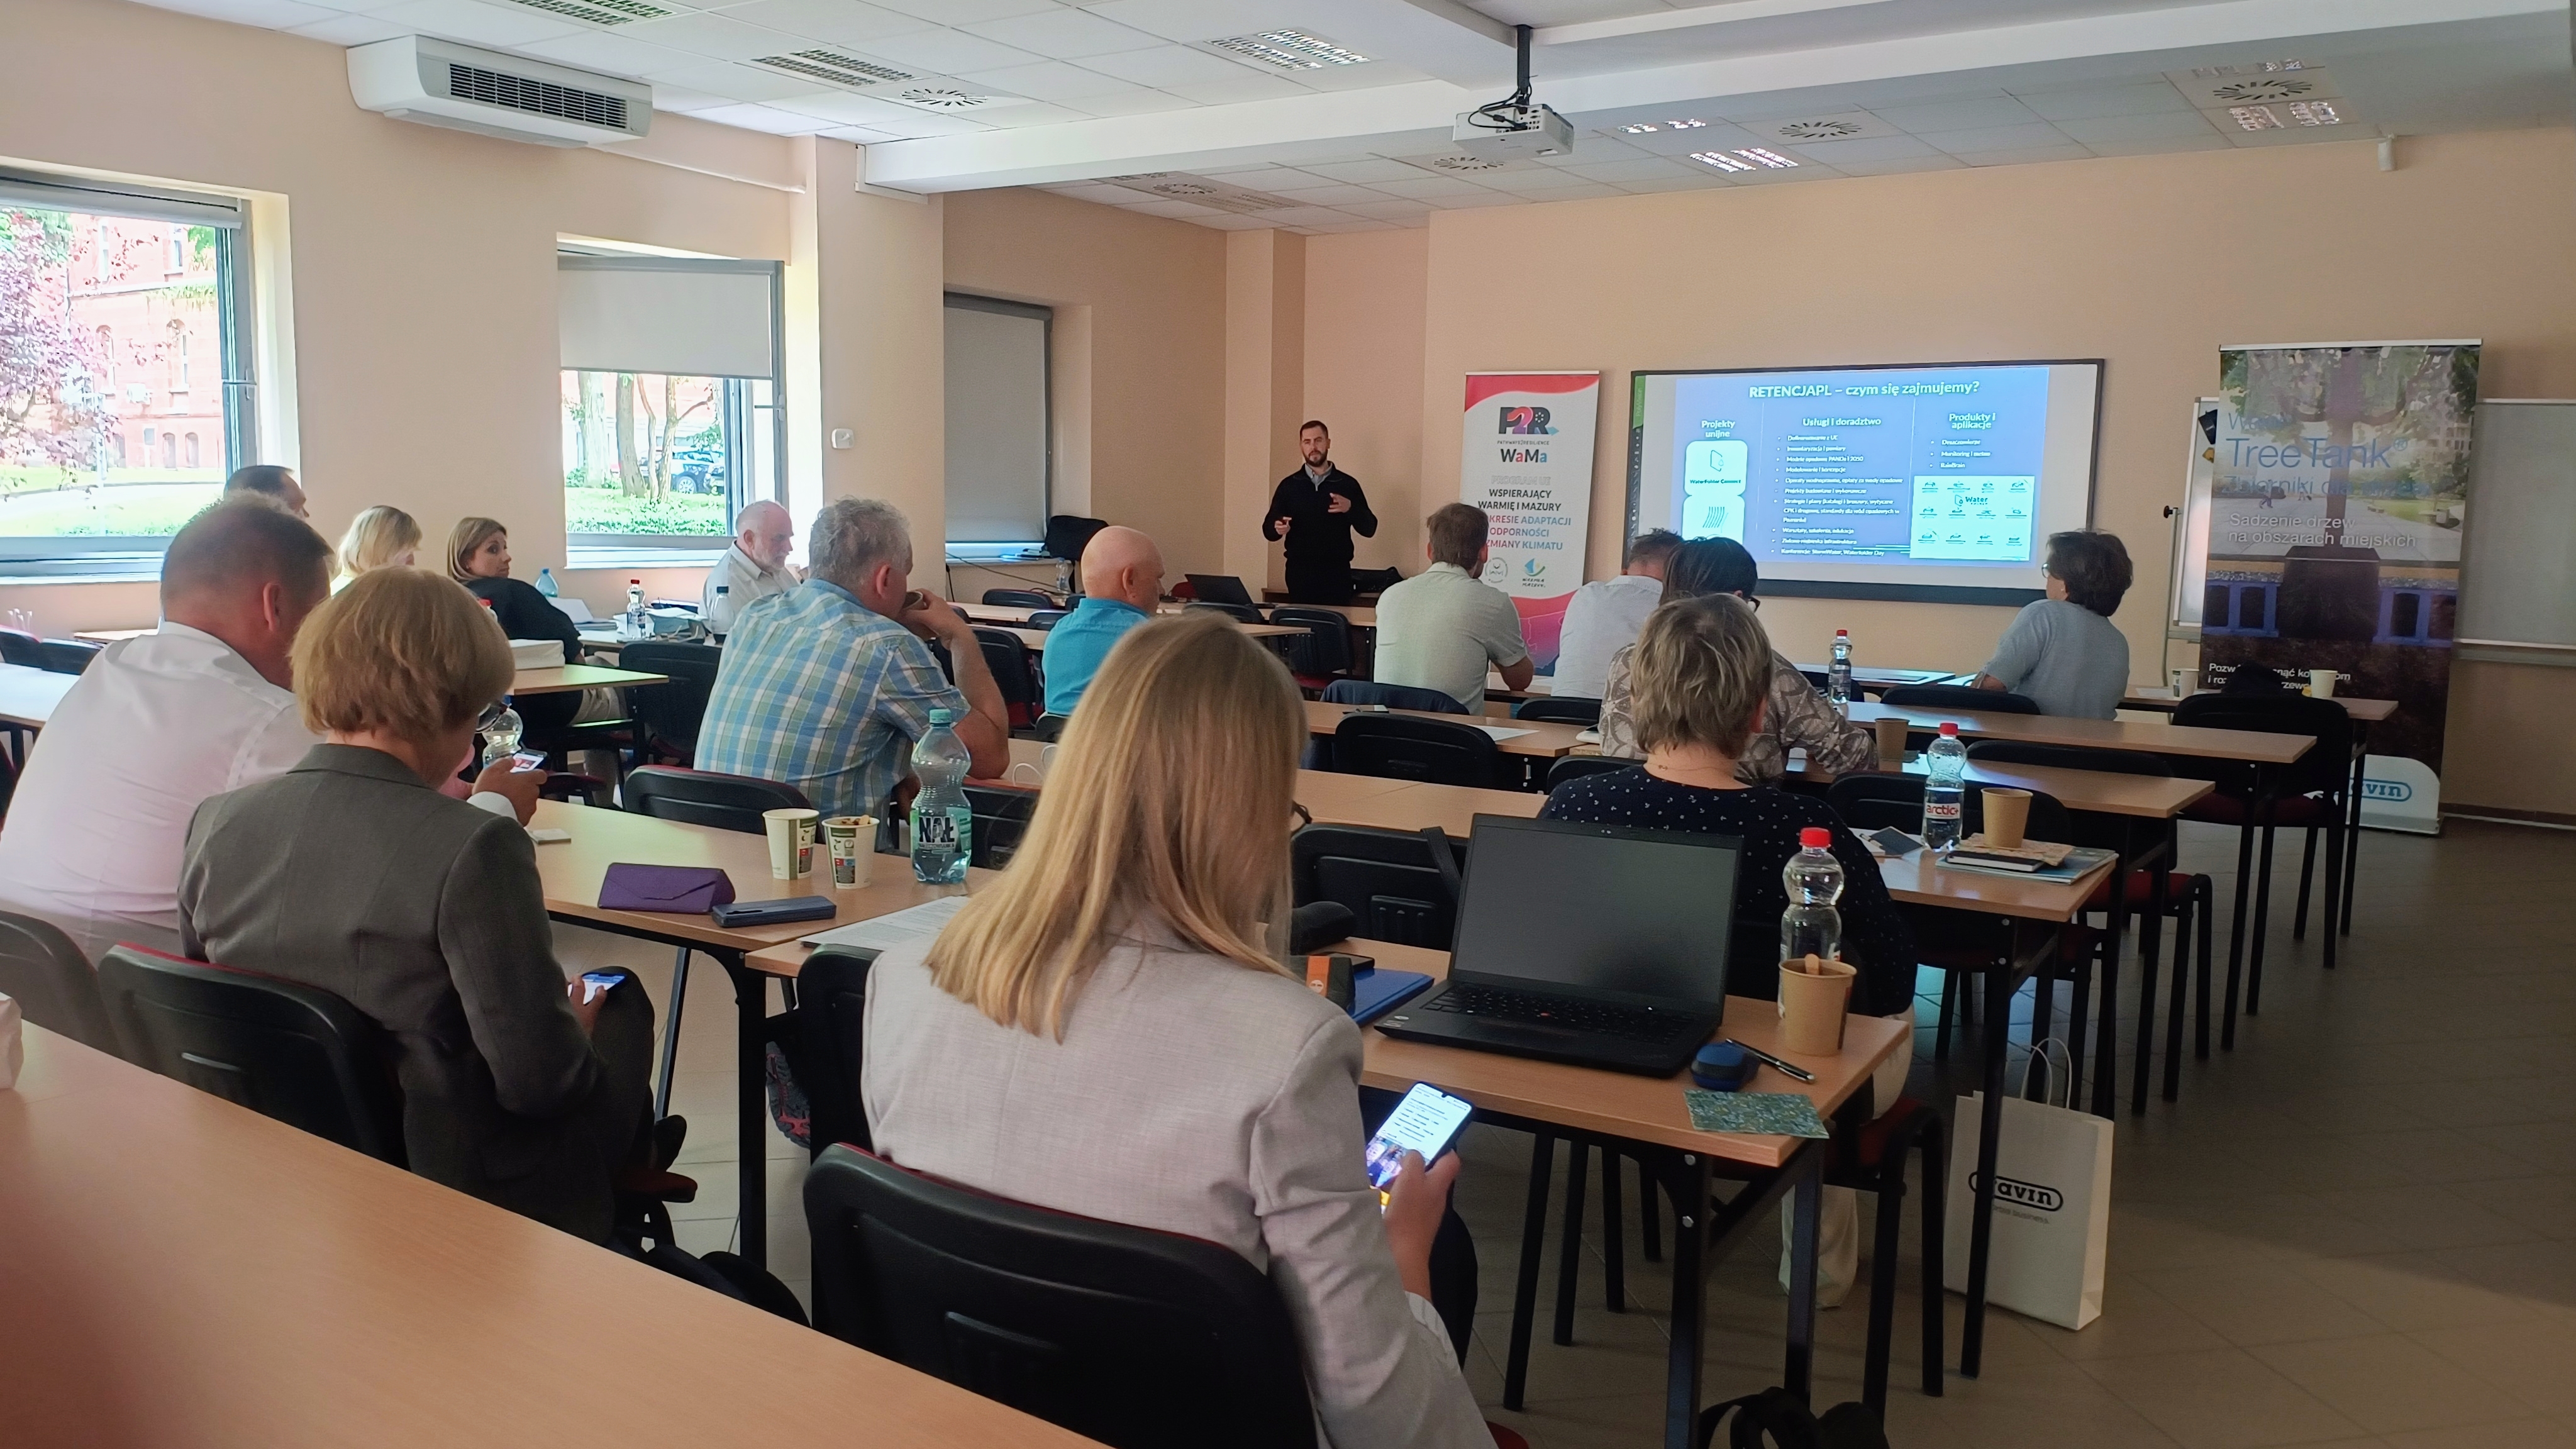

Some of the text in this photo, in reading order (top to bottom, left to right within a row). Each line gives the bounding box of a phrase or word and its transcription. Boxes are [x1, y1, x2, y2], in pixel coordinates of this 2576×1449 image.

[1749, 386, 1831, 398] RETENCJAPL
[1845, 386, 1879, 397] czym
[1881, 383, 1899, 396] się
[1902, 381, 1980, 396] zajmujemy?
[1499, 406, 1550, 434] P2R
[1948, 412, 1996, 422] Produkty i
[1701, 419, 1736, 429] Projekty
[1802, 418, 1829, 427] Usługi
[1835, 418, 1882, 426] doradztwo
[1951, 421, 1992, 430] aplikacje
[1705, 430, 1730, 439] unijne
[1501, 448, 1547, 463] WaMa
[1491, 475, 1552, 486] PROGRAM UE
[1489, 489, 1552, 499] WSPIERAJĄCY
[1478, 501, 1515, 511] WARMIĘ
[1521, 502, 1562, 511] MAZURY
[1489, 515, 1572, 526] KRESIE ADAPTACJI
[2229, 513, 2356, 528] Sadzenie drzew
[1489, 528, 1550, 537] ODPORNOŚCI
[2228, 530, 2416, 549] na obszarach miejskich
[1522, 541, 1563, 550] KLIMATU
[2209, 663, 2241, 673] Pozw
[1996, 1180, 2052, 1206] avin
